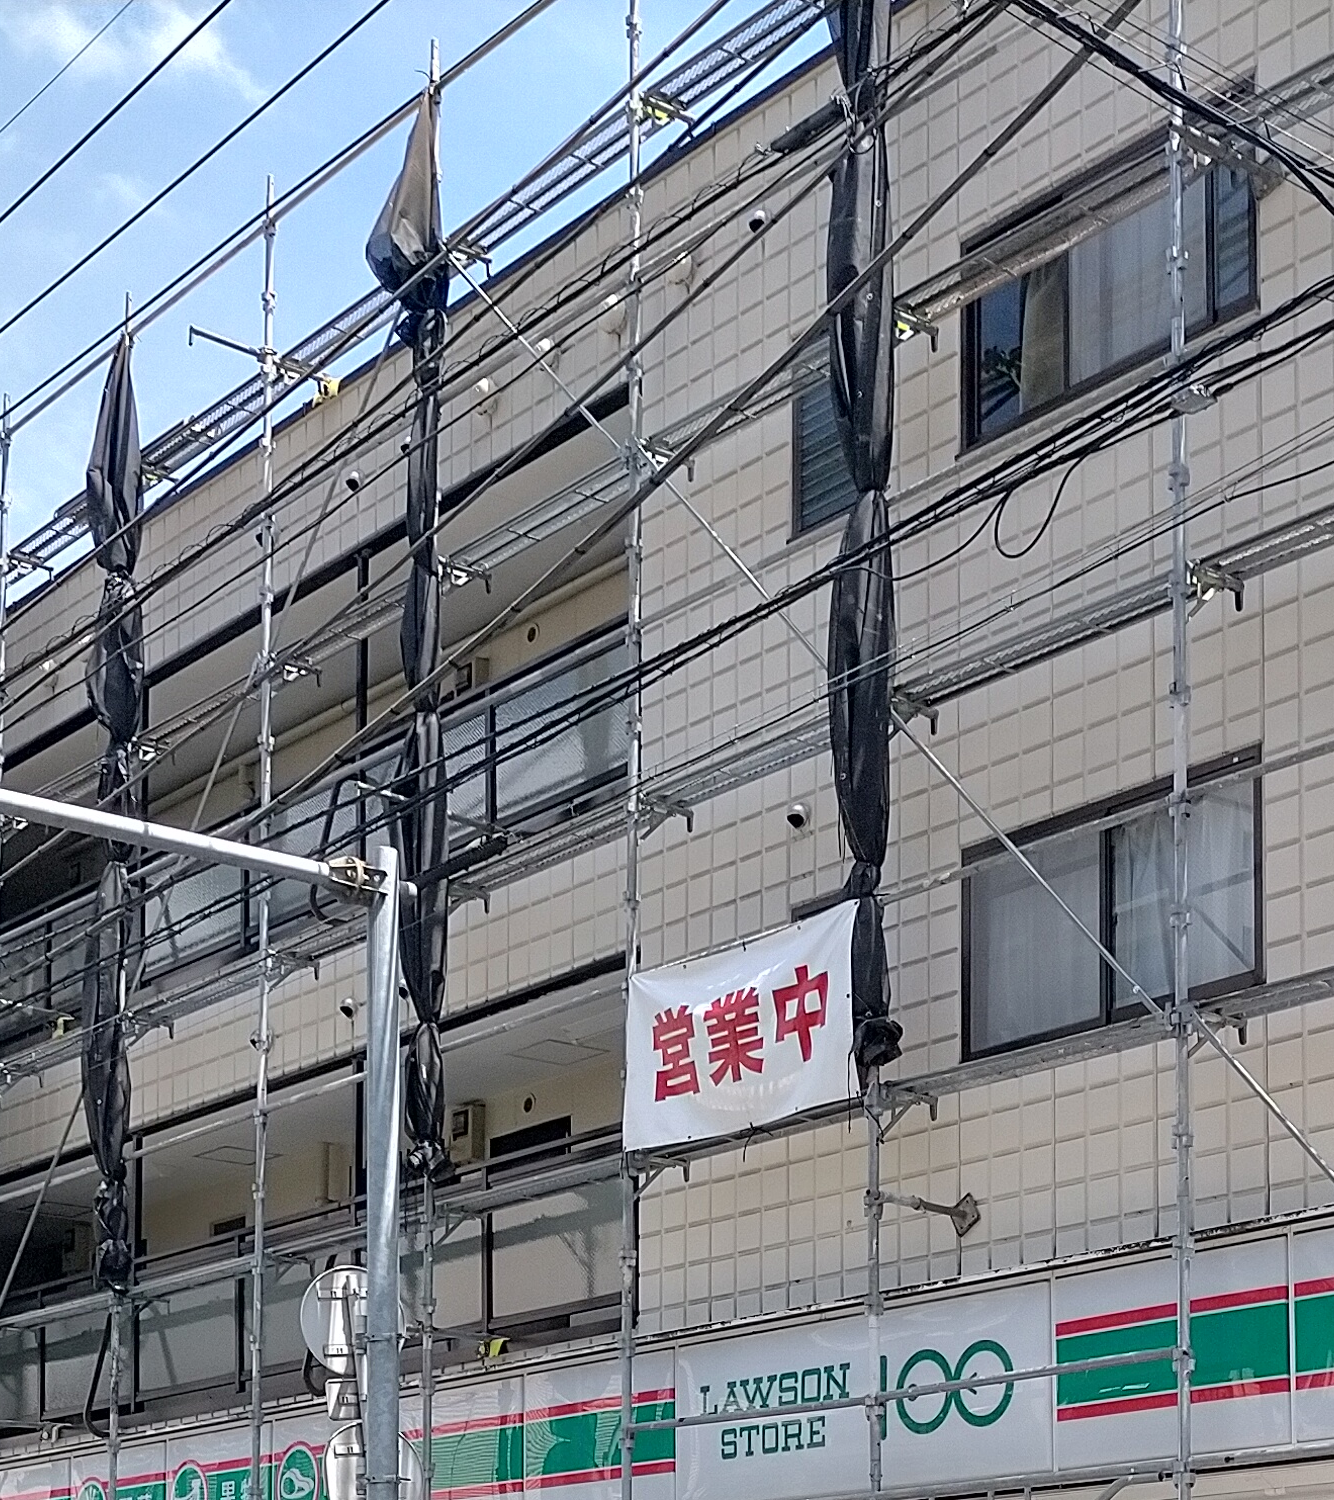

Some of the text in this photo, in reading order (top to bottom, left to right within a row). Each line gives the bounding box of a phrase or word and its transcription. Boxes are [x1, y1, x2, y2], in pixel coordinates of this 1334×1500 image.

[652, 964, 829, 1102] 営業中
[699, 1362, 851, 1416] LAWSON
[879, 1340, 1014, 1441] 100
[721, 1416, 826, 1460] STORE
